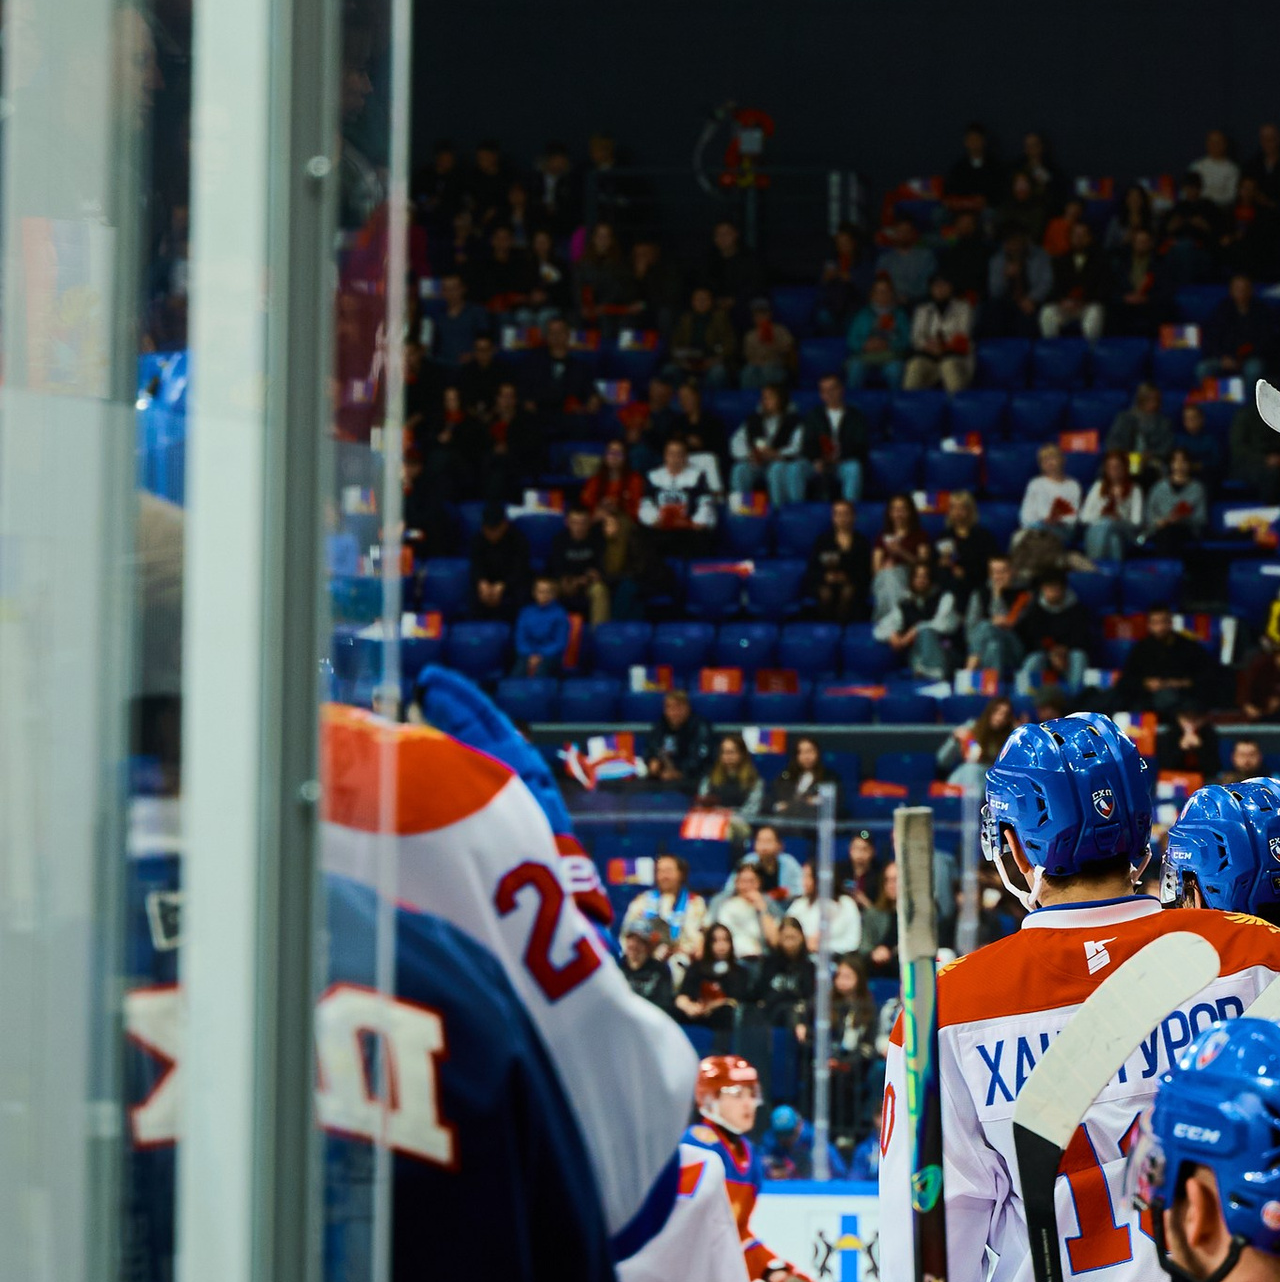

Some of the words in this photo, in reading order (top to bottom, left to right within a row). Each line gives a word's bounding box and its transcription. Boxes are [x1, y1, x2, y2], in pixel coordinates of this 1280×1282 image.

[989, 799, 1010, 811] CCM
[1173, 850, 1193, 861] CCM
[1173, 1122, 1221, 1145] CCM
